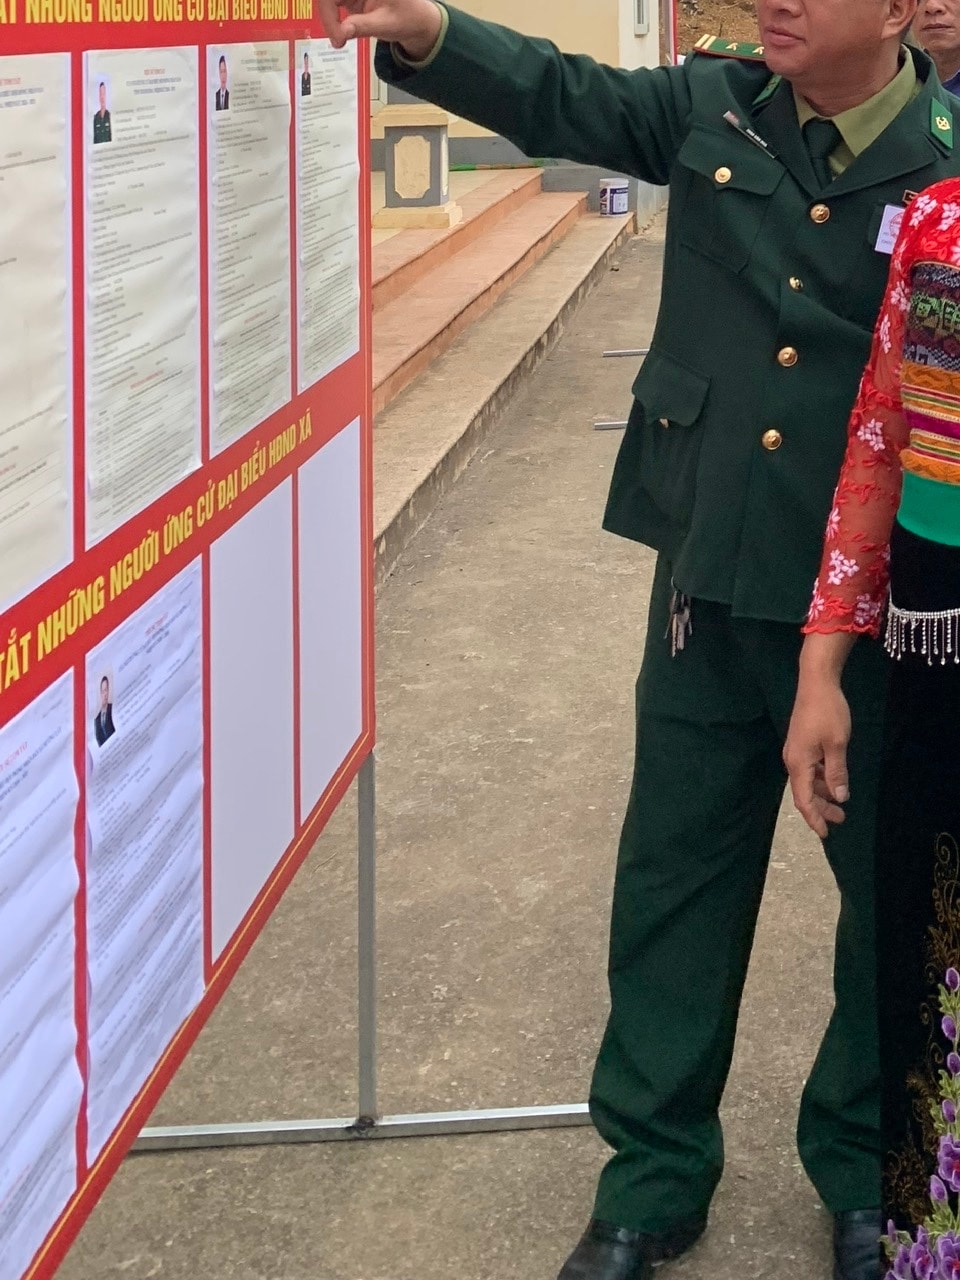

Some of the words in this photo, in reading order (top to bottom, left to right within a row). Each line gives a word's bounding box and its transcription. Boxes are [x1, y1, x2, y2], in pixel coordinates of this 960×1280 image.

[38, 575, 104, 662] NHỮNG
[110, 528, 159, 601] NGƯỜI
[164, 513, 193, 555] ỨNG
[196, 479, 216, 528] CỬ
[218, 468, 238, 512] ĐẠI
[240, 440, 266, 493] BIỂU
[268, 423, 297, 469] HĐND
